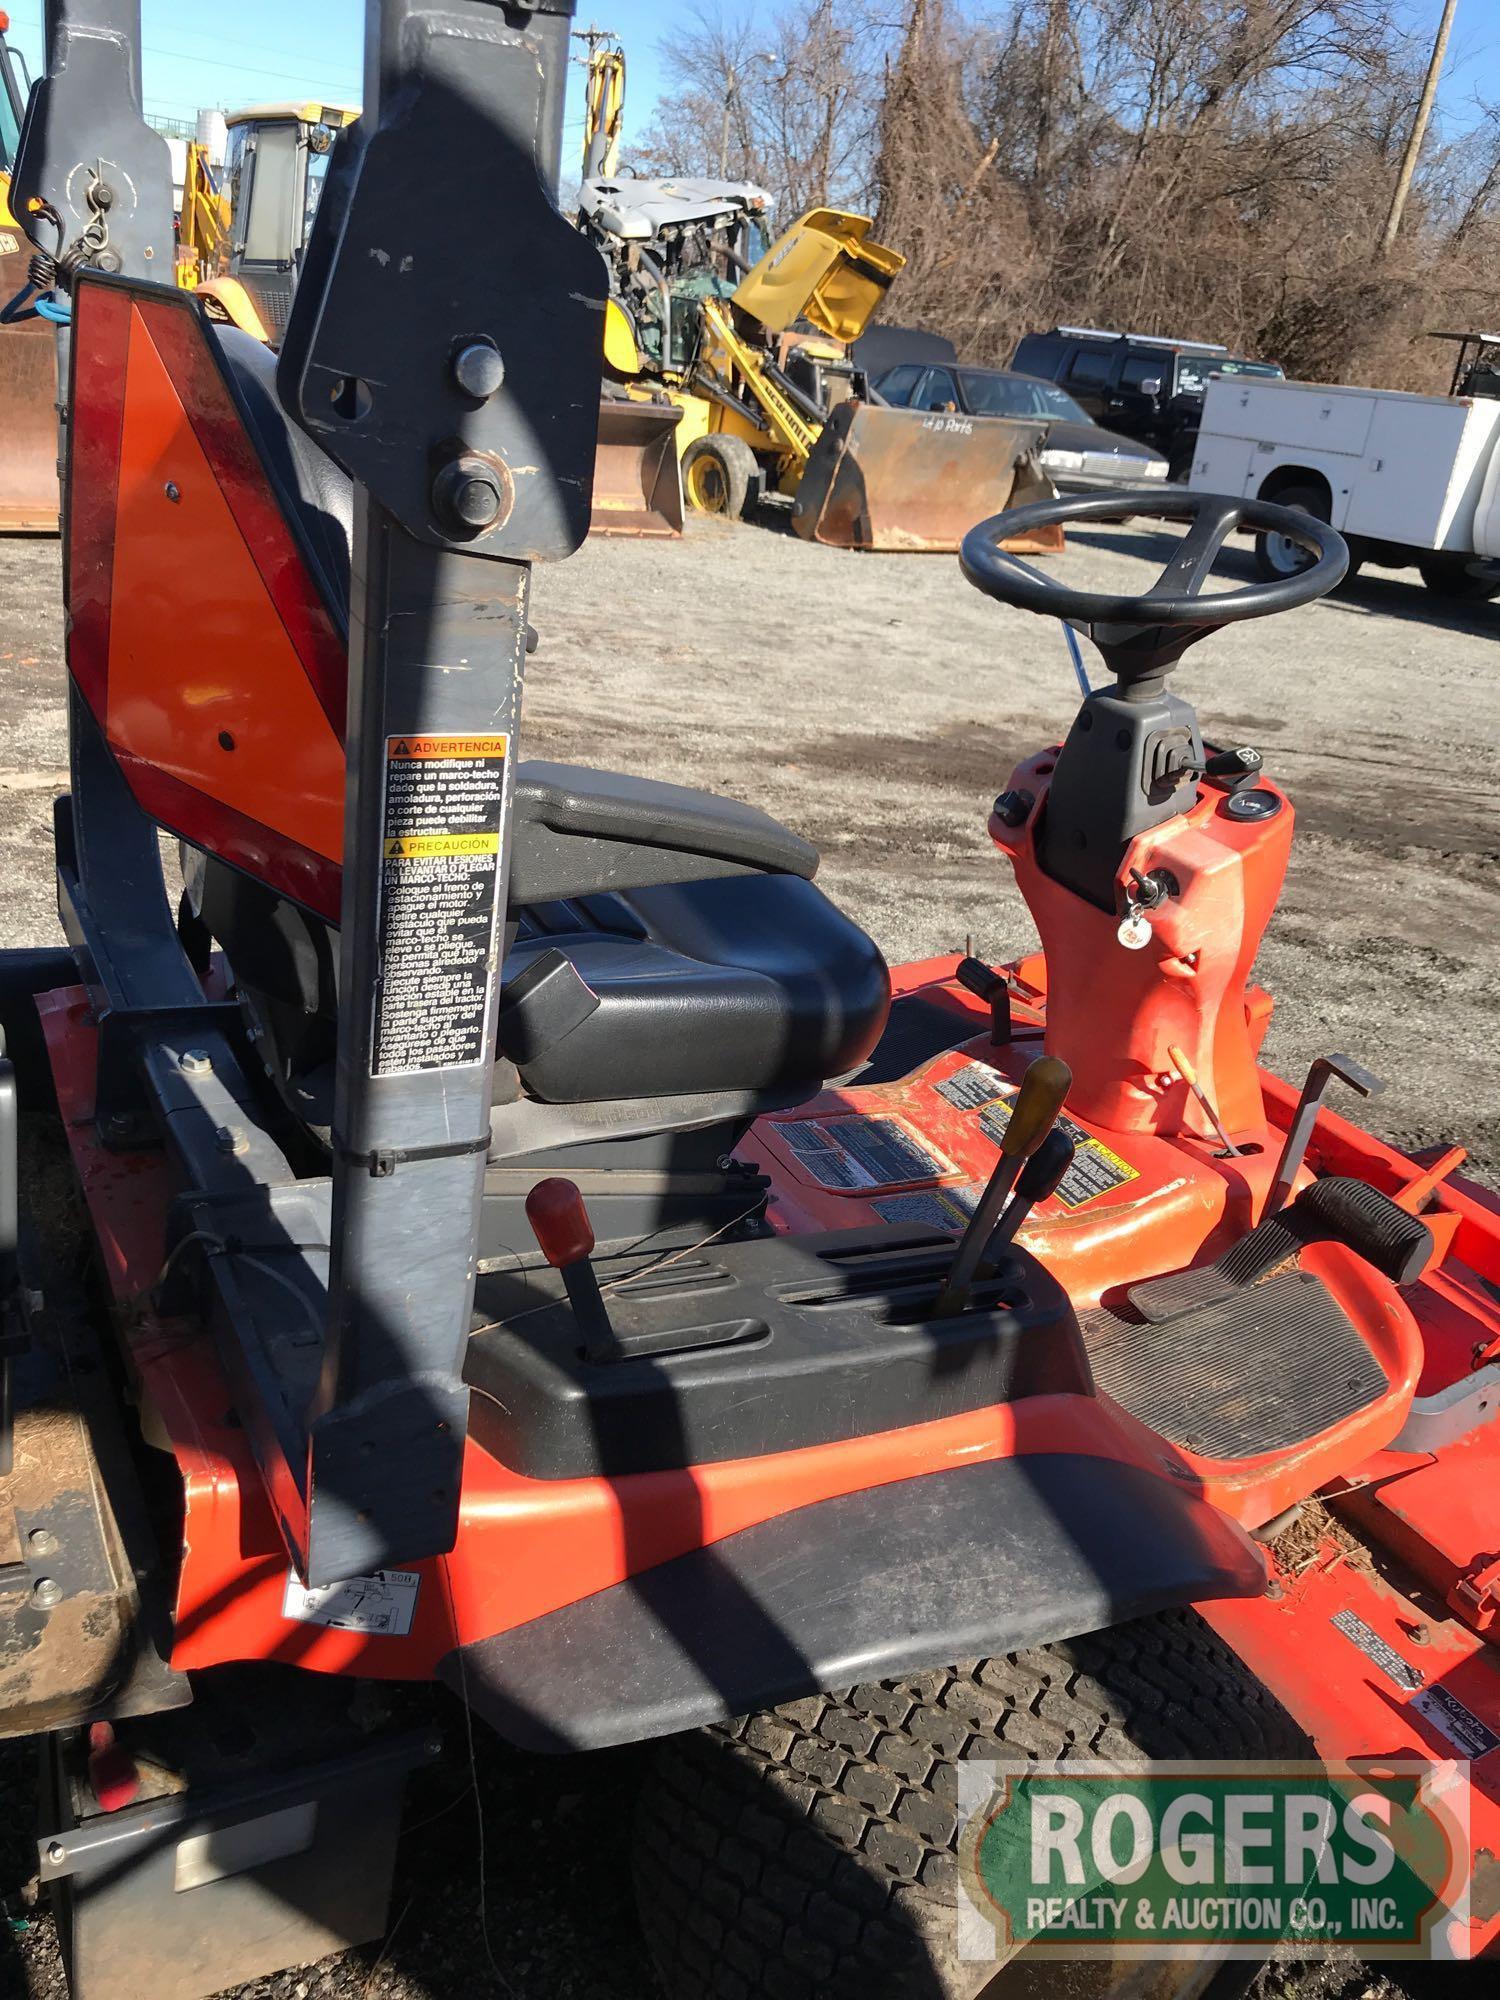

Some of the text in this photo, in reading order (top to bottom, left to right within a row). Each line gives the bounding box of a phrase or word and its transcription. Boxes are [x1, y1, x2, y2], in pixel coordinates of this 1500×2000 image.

[413, 742, 502, 753] ADVERTENCIA
[390, 758, 484, 770] Nunca modifique ni
[390, 770, 500, 782] repare un marco-techo
[390, 780, 499, 794] dado que la soldadura,
[388, 792, 500, 804] amoladura, perforación
[397, 805, 422, 814] corte
[424, 805, 438, 814] de
[439, 804, 484, 814] cualquier
[388, 814, 487, 827] pieza puede debilitar
[387, 828, 450, 837] la estructura.
[409, 839, 489, 852] PRECAUCIÓN
[385, 854, 493, 868] PARA EVITAR LESIONES
[385, 862, 495, 876] AL LEVANTAR O PLEGAR
[384, 873, 470, 886] UN MARCO-TECHO:
[432, 884, 442, 892] el
[444, 883, 469, 892] freno
[472, 882, 484, 890] de
[388, 891, 482, 903] estacionamiento y
[388, 900, 470, 913] apague el motor.
[420, 908, 465, 920] cualquier
[386, 915, 488, 930] obstáculo que pueda
[386, 925, 446, 938] evitar que el
[385, 946, 412, 954] eleve
[438, 940, 476, 952] pliegue.
[386, 935, 448, 946] marco-techo
[402, 952, 438, 962] permita
[441, 951, 460, 960] que
[462, 947, 486, 957] haya
[384, 956, 478, 970] personas alrededor
[384, 967, 444, 978] observando.
[422, 974, 462, 984] siempre
[464, 972, 472, 980] la
[383, 980, 471, 995] función desde una
[382, 992, 422, 1004] posición
[424, 988, 460, 998] estable
[476, 986, 484, 994] la
[382, 994, 484, 1012] parte trasera del tractor.
[430, 1002, 484, 1014] firmemente
[380, 1011, 476, 1028] la parte superior del
[380, 1020, 452, 1034] marco-techo al
[380, 1026, 482, 1043] levantarlo o plegarlo.
[434, 1036, 446, 1044] de
[448, 1035, 466, 1044] que
[378, 1042, 476, 1060] todos los pasadores
[378, 1057, 406, 1067] estén
[408, 1052, 456, 1064] instalados
[458, 1051, 464, 1060] y
[378, 1063, 423, 1074] trabados.
[1099, 1146, 1136, 1179] CAUTION
[1445, 1697, 1484, 1735] Kubota
